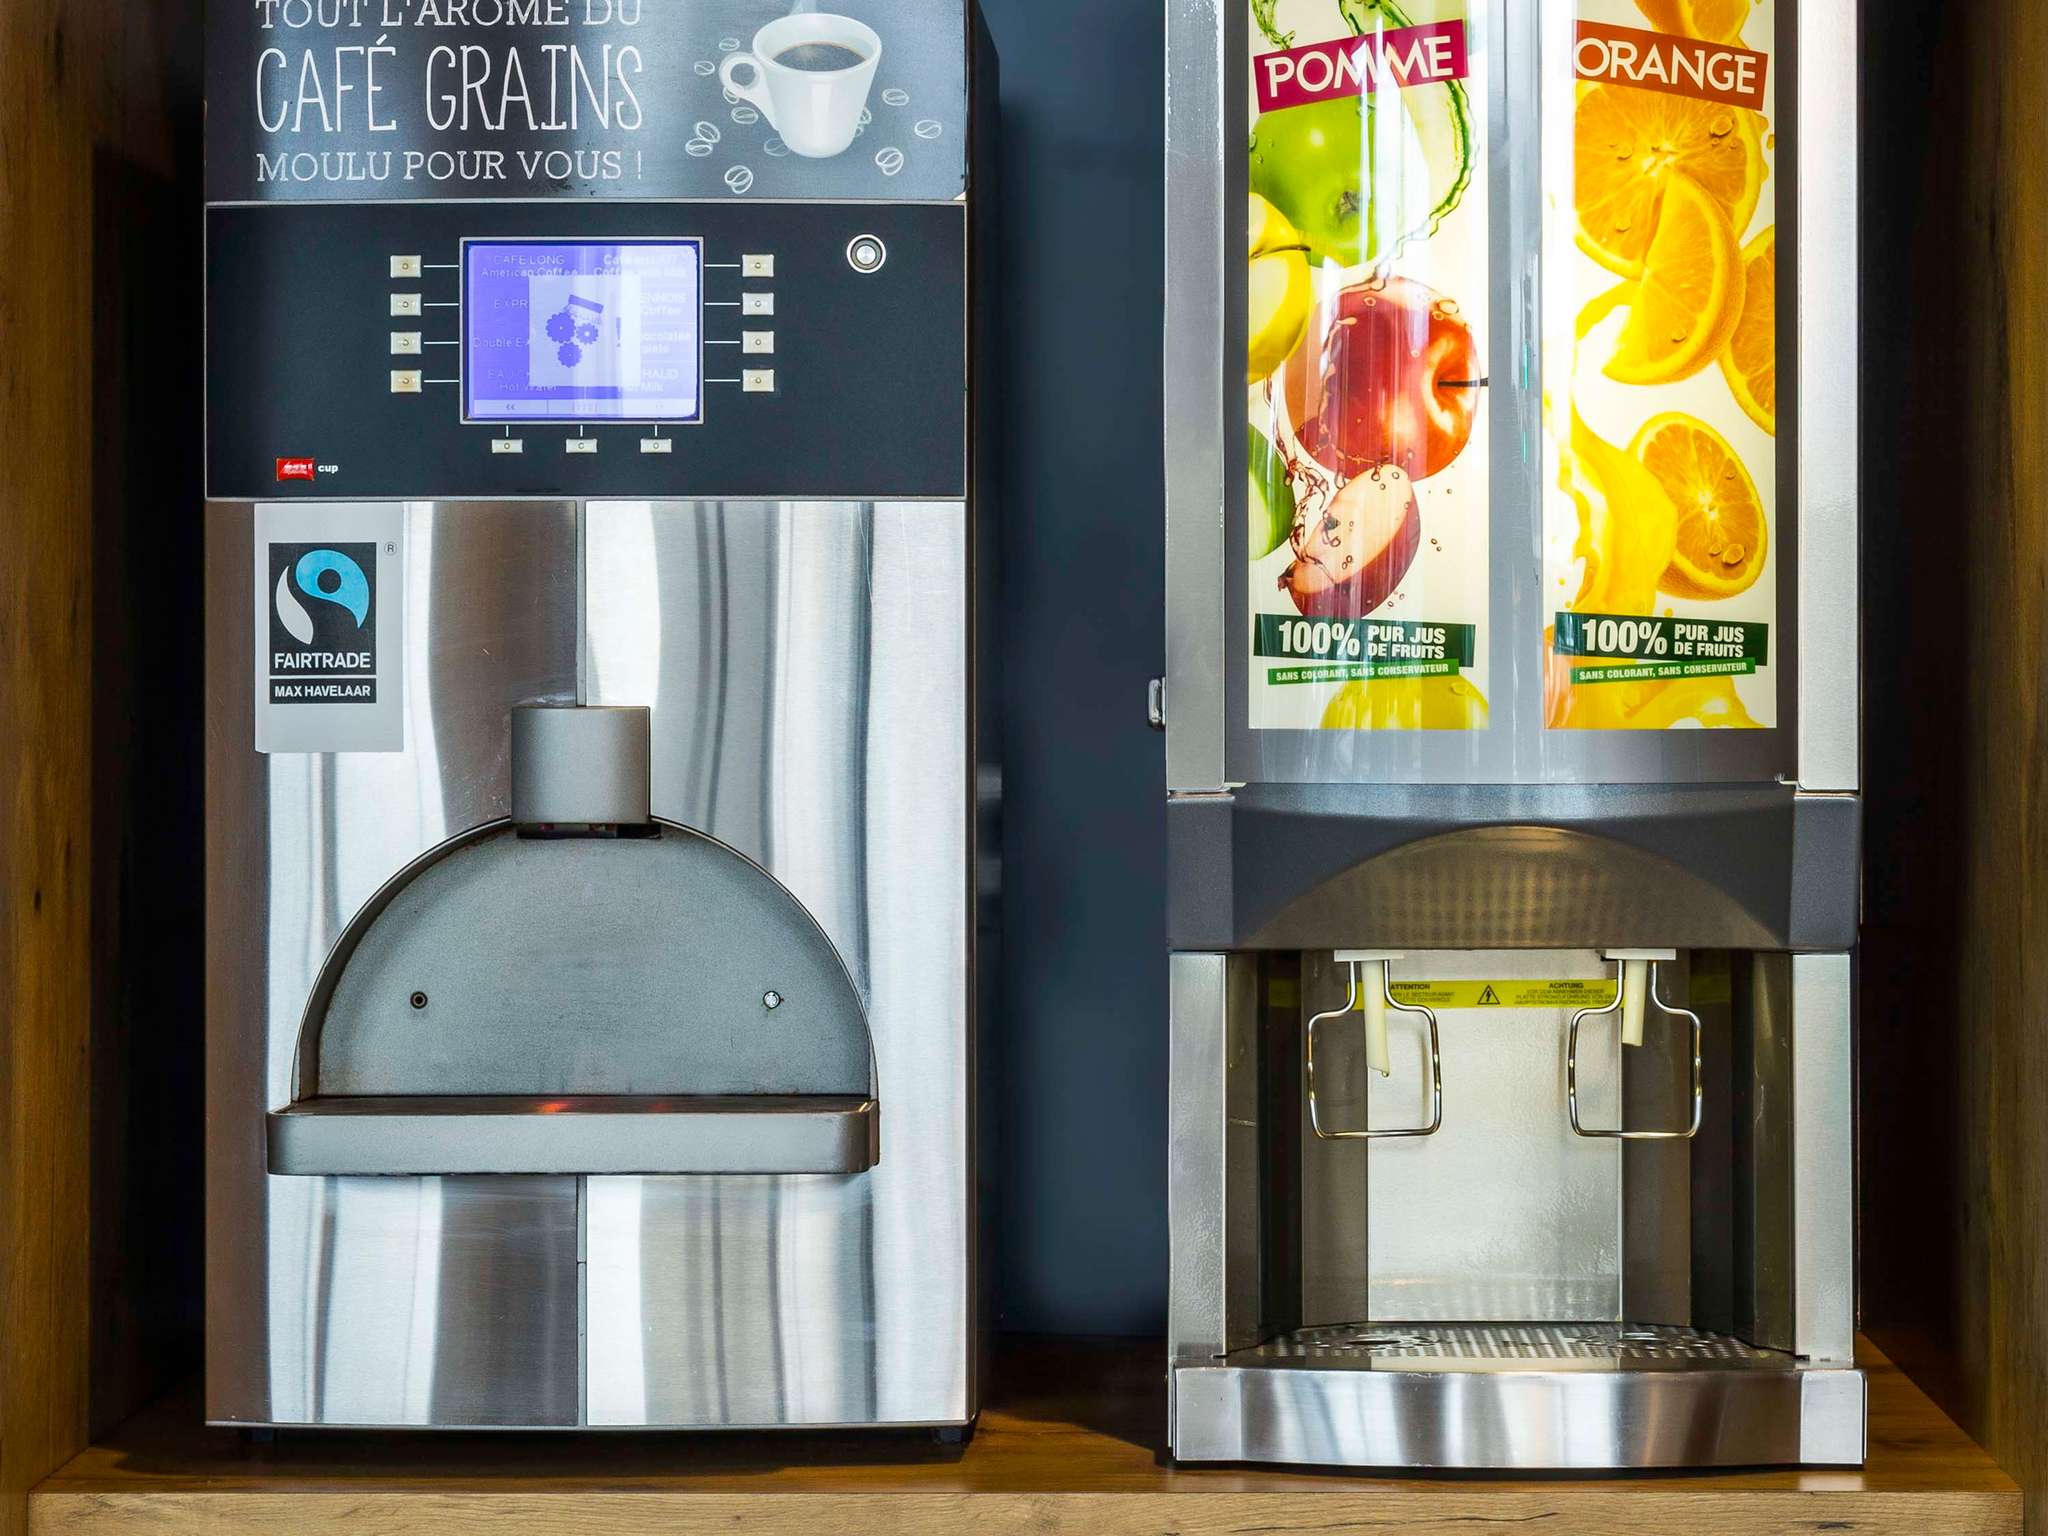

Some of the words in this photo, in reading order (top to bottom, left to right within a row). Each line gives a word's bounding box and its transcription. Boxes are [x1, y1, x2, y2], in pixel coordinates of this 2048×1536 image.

[256, 0, 368, 28] TOUT
[583, 0, 641, 26] DU
[1264, 36, 1453, 98] POMME
[1575, 37, 1757, 95] ORANGE
[256, 34, 397, 132] CAFÉ
[426, 45, 642, 131] GRAINS
[256, 151, 392, 182] MOULU
[403, 150, 507, 181] POUR
[516, 150, 622, 180] VOUS
[317, 464, 339, 474] cup
[1278, 620, 1361, 656] 100%
[1368, 625, 1405, 642] PUR
[1409, 627, 1446, 644] JUS
[1582, 618, 1668, 655] 100%
[1674, 623, 1709, 641] PUR
[1713, 626, 1745, 643] JUS
[274, 652, 371, 669] FAIRTRADE
[1368, 643, 1387, 657] DE
[1391, 643, 1445, 659] FRUITS
[1674, 641, 1693, 655] DE
[1696, 643, 1744, 658] FRUITS
[1276, 671, 1299, 681] SANS
[1350, 666, 1375, 677] SANS
[1377, 663, 1449, 676] CONSERVATEUR
[1579, 670, 1604, 680] SANS
[1658, 665, 1682, 675] SANS
[1683, 662, 1748, 674] CONSERVATEUR
[274, 685, 302, 697] MAX
[304, 685, 371, 697] HAVELAAR
